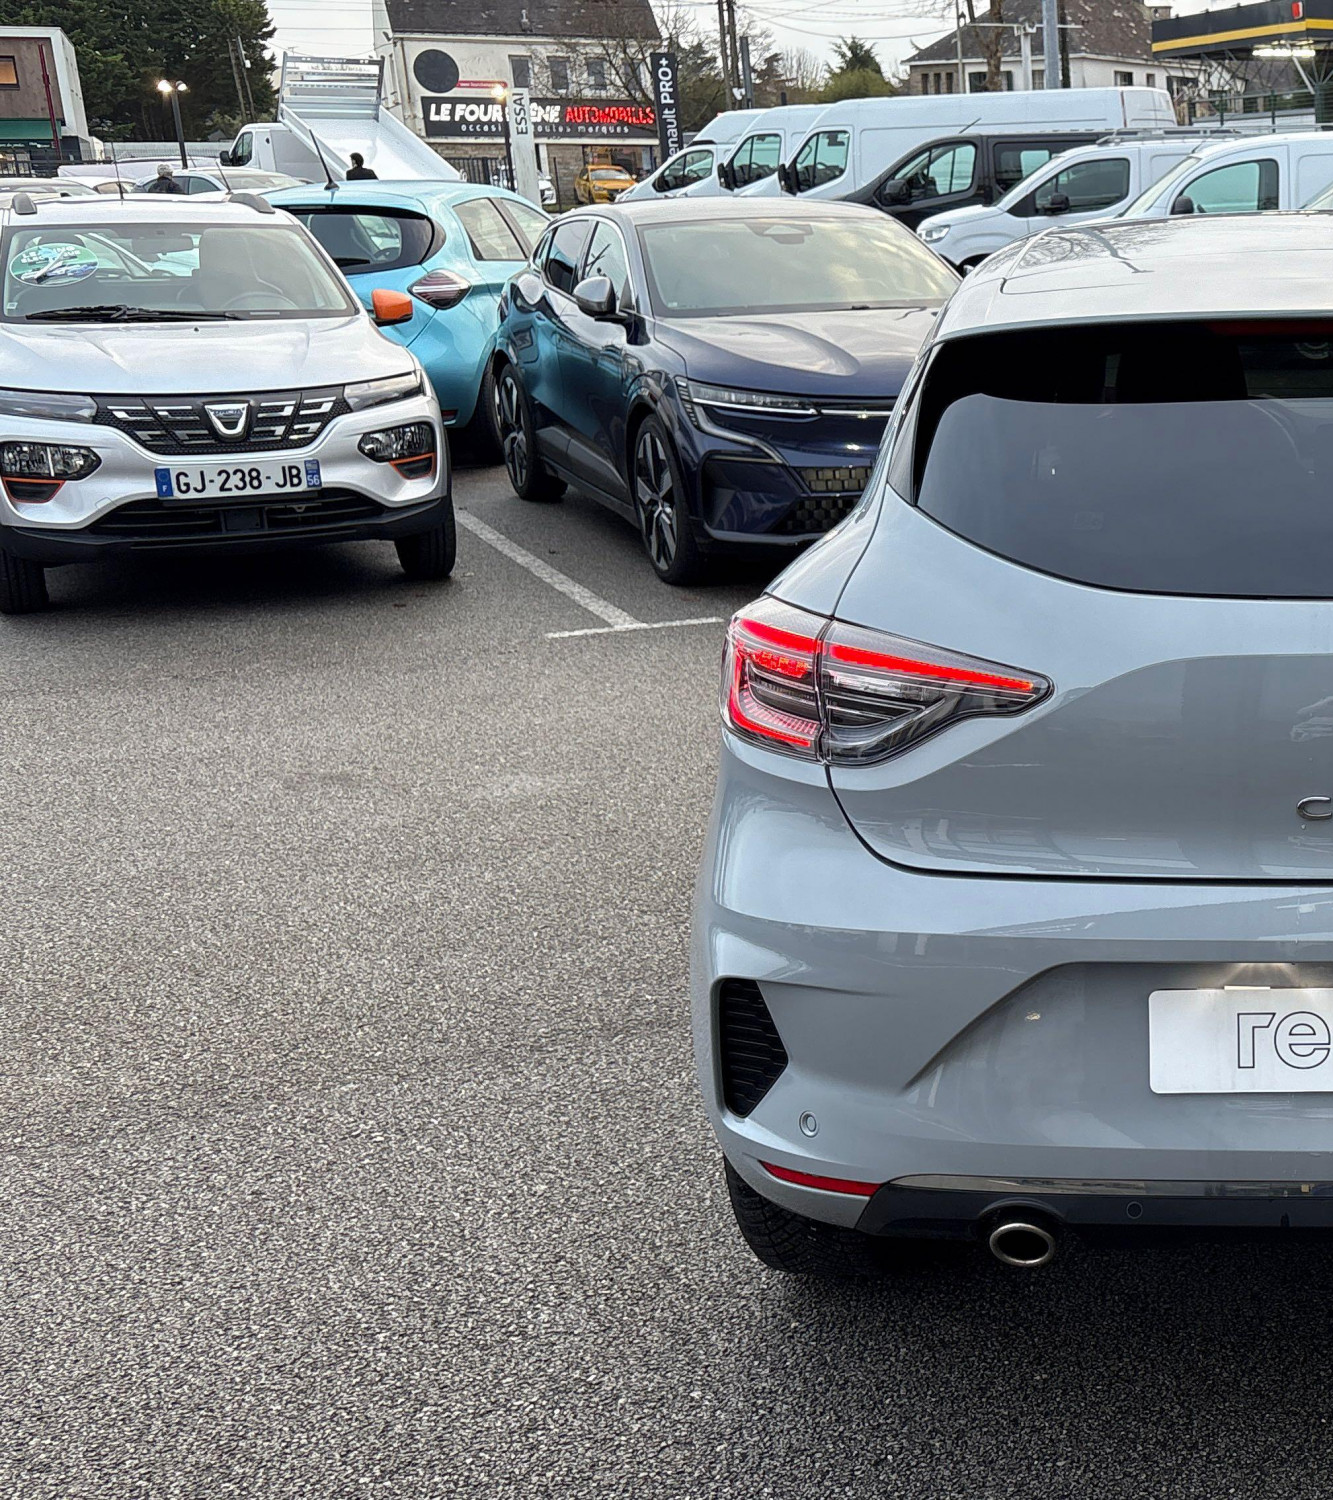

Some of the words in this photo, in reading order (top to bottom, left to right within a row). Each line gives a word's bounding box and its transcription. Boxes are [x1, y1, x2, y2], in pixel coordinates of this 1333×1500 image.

[658, 57, 675, 104] PRO+
[429, 103, 452, 121] LE
[454, 102, 560, 123] FOURÊNE
[565, 106, 655, 124] AUTOMOBILES
[512, 93, 528, 135] ESSAI
[662, 108, 680, 158] enault
[162, 485, 168, 493] F
[175, 465, 303, 494] GJ-238-JB
[307, 474, 320, 486] 56
